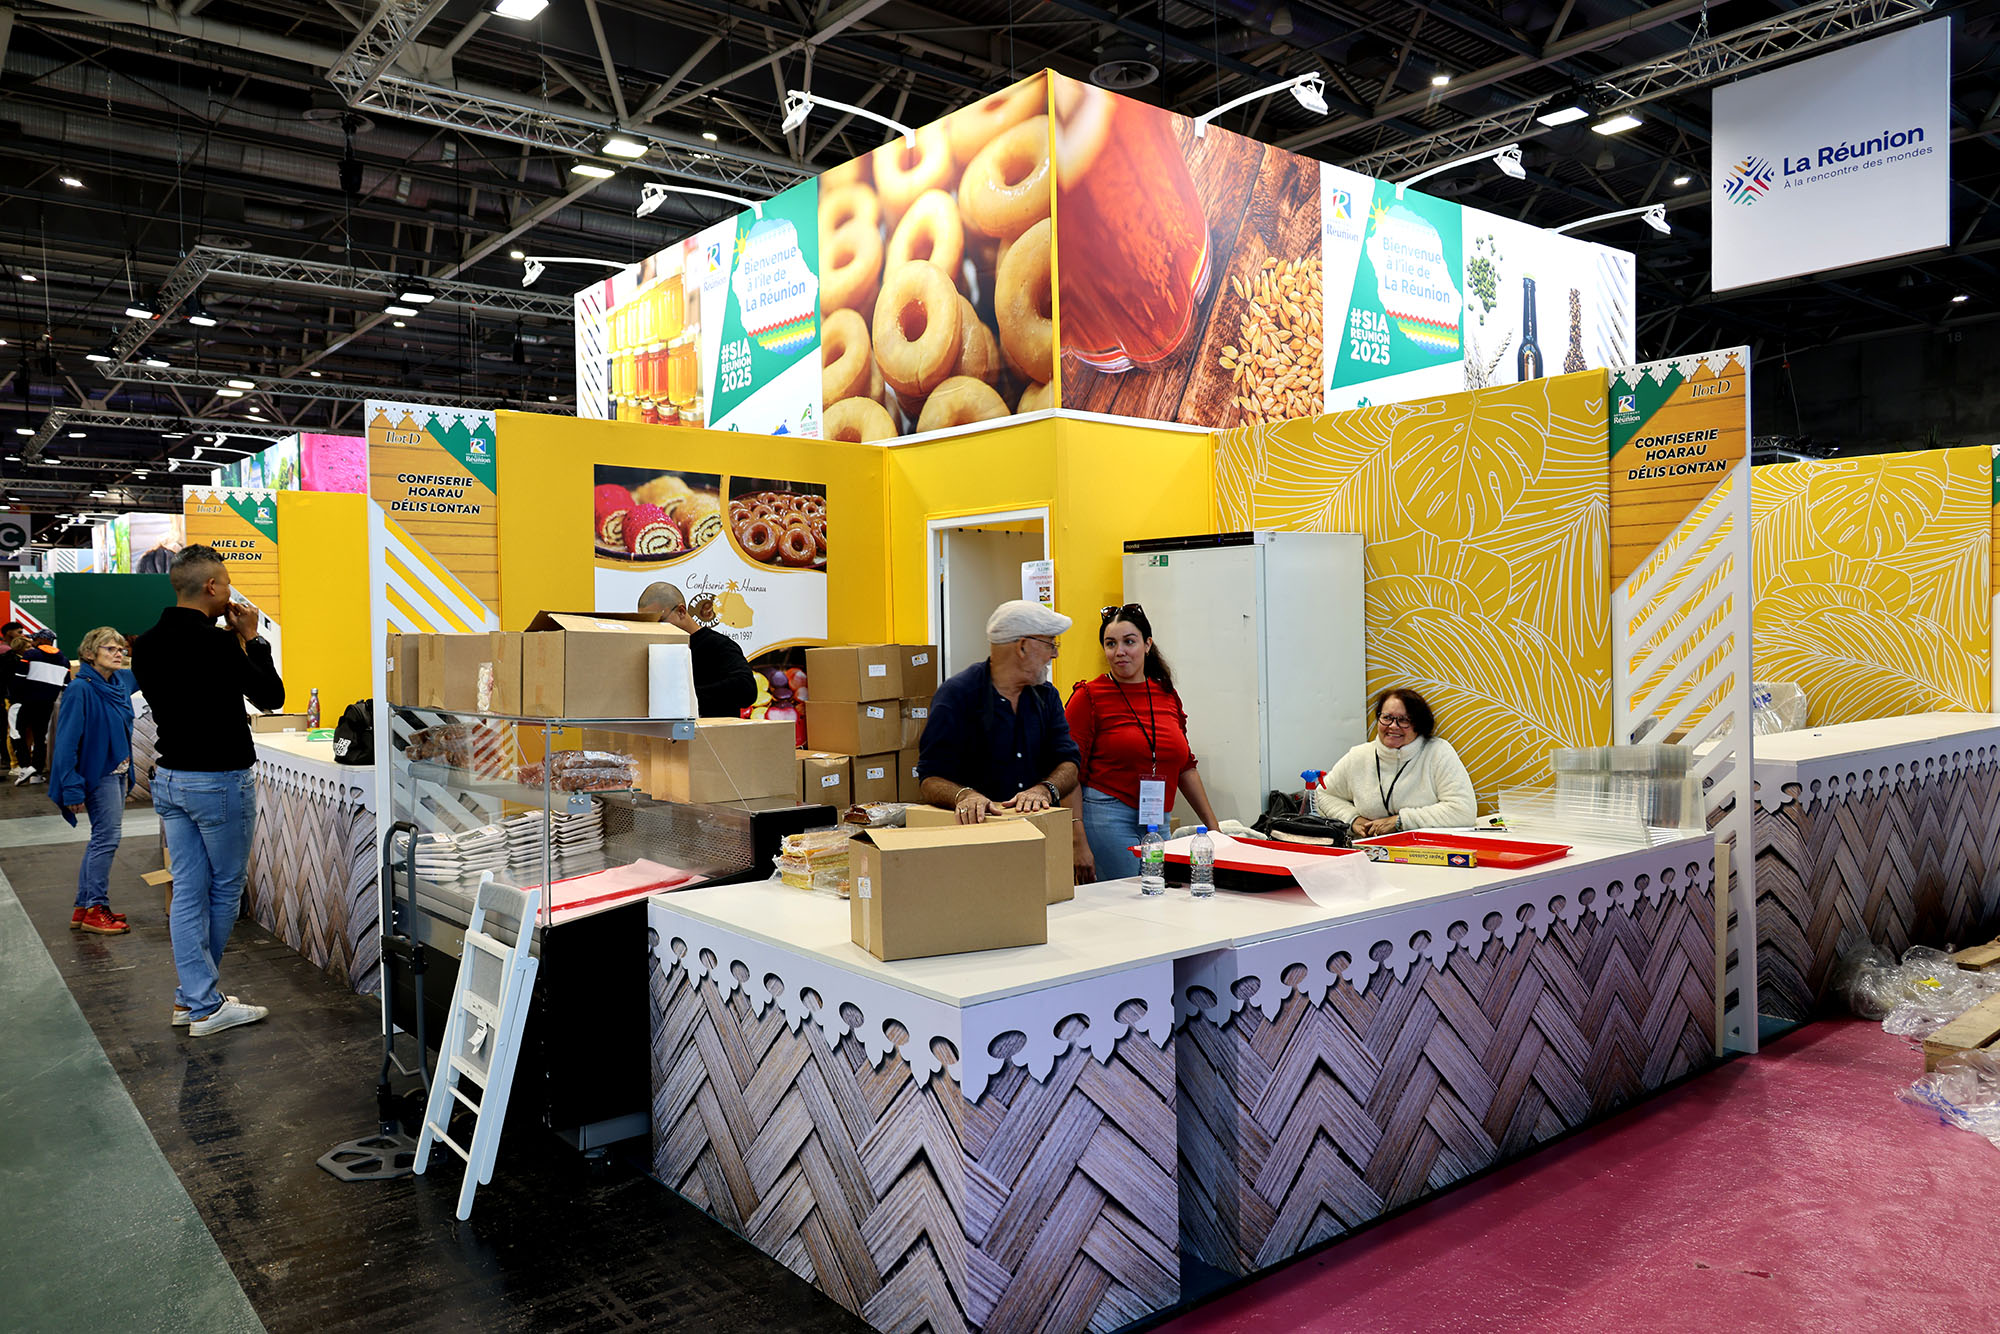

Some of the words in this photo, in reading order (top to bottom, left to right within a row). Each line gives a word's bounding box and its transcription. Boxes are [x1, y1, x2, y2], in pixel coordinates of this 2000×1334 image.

[1784, 156, 1811, 176] La
[1818, 127, 1924, 167] Réunion
[1784, 178, 1792, 189] À
[1794, 177, 1804, 187] la
[1806, 164, 1858, 183] rencontre
[1862, 157, 1883, 170] des
[1886, 146, 1933, 164] mondes
[744, 246, 796, 275] Bienvenue
[1383, 236, 1441, 264] Bienvenue
[1386, 256, 1392, 270] à
[1416, 266, 1430, 280] de
[748, 278, 752, 292] à
[774, 268, 786, 282] de
[1384, 274, 1398, 291] La
[1402, 280, 1450, 304] Réunion
[746, 298, 757, 312] La
[760, 281, 806, 307] Réunion
[1350, 308, 1390, 334] #SIA
[1350, 328, 1390, 345] REUNION
[721, 338, 752, 364] #SIA
[1350, 338, 1390, 366] 2025
[722, 355, 752, 374] REUNION
[722, 366, 752, 393] 2025
[1635, 428, 1718, 448] CONFISERIE
[1646, 444, 1707, 461] HOARAU
[398, 474, 473, 487] CONFISERIE
[1628, 464, 1666, 480] DÉLIS
[1669, 460, 1727, 476] LONTAN
[408, 486, 464, 498] HOARAU
[391, 499, 428, 512] DÉLIS
[430, 504, 480, 514] LONTAN
[211, 540, 238, 548] MIEL
[686, 573, 724, 594] Confiserie
[690, 594, 713, 608] MADE
[740, 632, 752, 640] 1997
